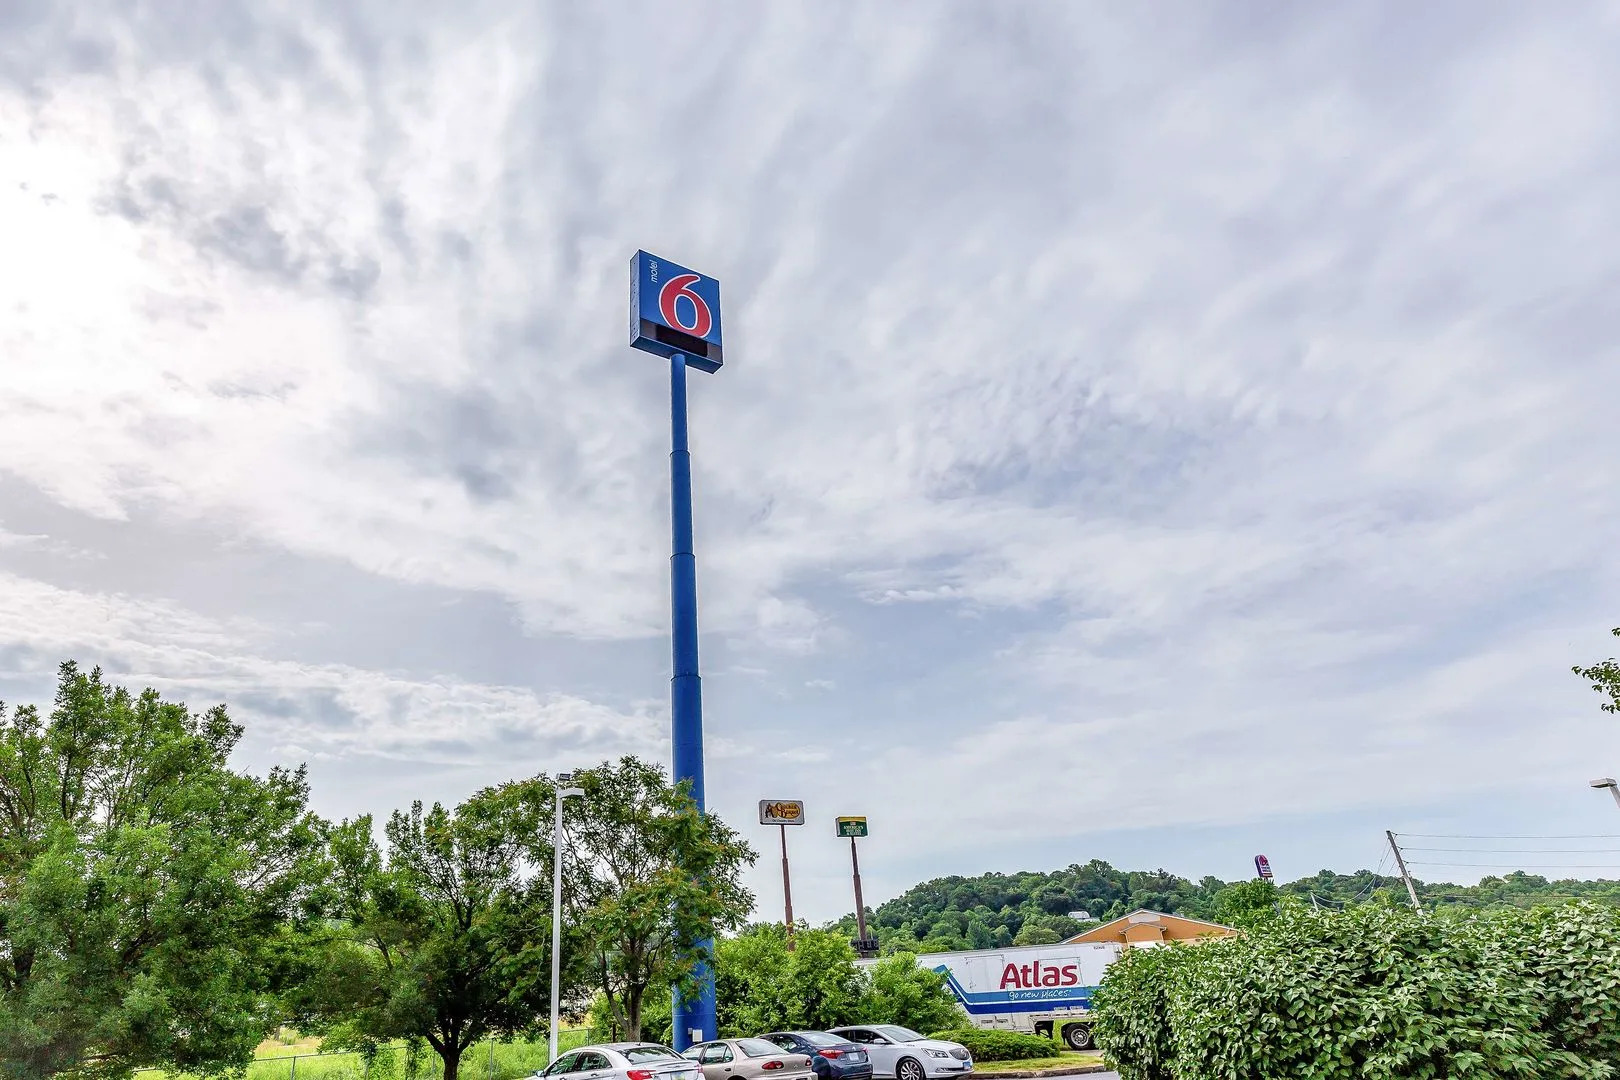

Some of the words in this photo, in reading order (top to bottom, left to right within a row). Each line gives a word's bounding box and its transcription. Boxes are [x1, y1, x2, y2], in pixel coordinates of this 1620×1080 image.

[649, 260, 658, 283] motel
[659, 274, 712, 338] 6
[1000, 961, 1078, 989] Atlas
[1009, 991, 1019, 1000] go
[1020, 990, 1039, 998] new
